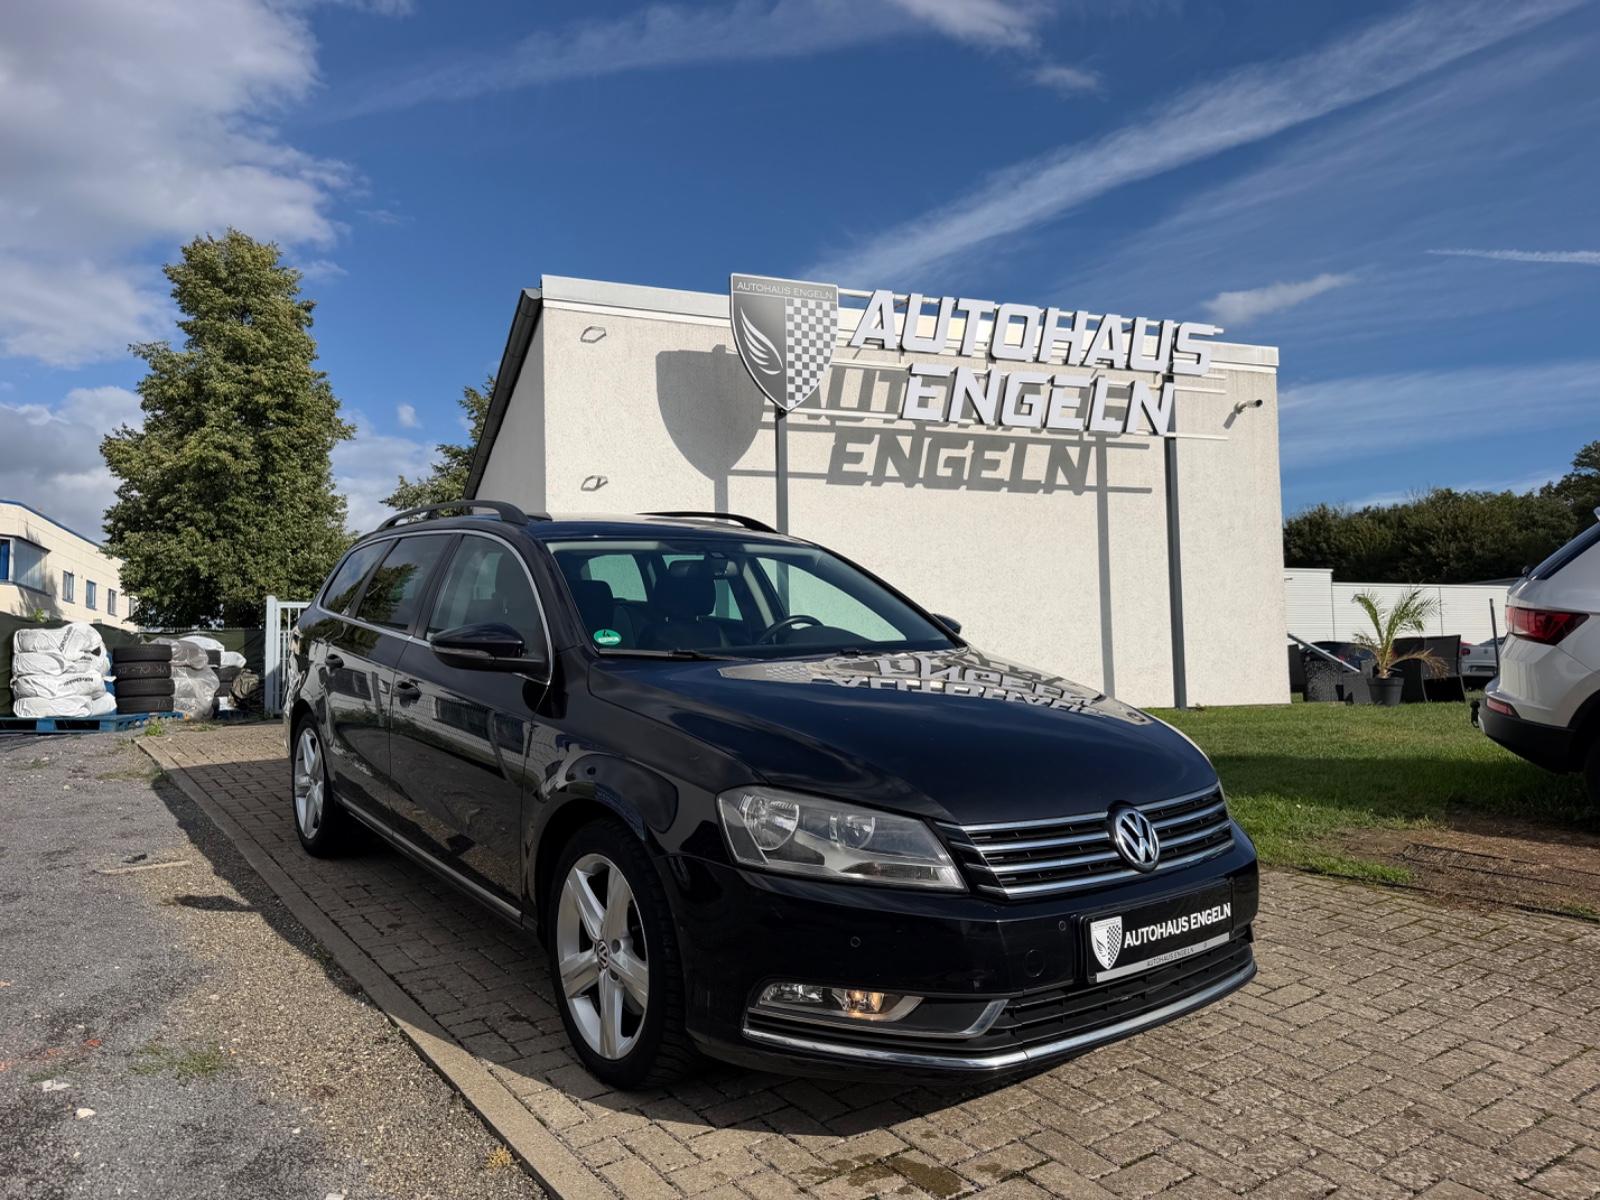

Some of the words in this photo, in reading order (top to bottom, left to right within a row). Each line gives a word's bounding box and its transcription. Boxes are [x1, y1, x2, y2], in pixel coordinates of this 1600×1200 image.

[736, 281, 791, 296] AUTOHAUS
[793, 287, 833, 300] ENGELN
[850, 289, 1216, 376] AUTOHAUS
[901, 363, 1175, 436] ENGELN
[1124, 916, 1190, 949] AUTOHAUS
[1190, 902, 1231, 930] ENGELN
[1146, 952, 1174, 967] AUTOHAUS
